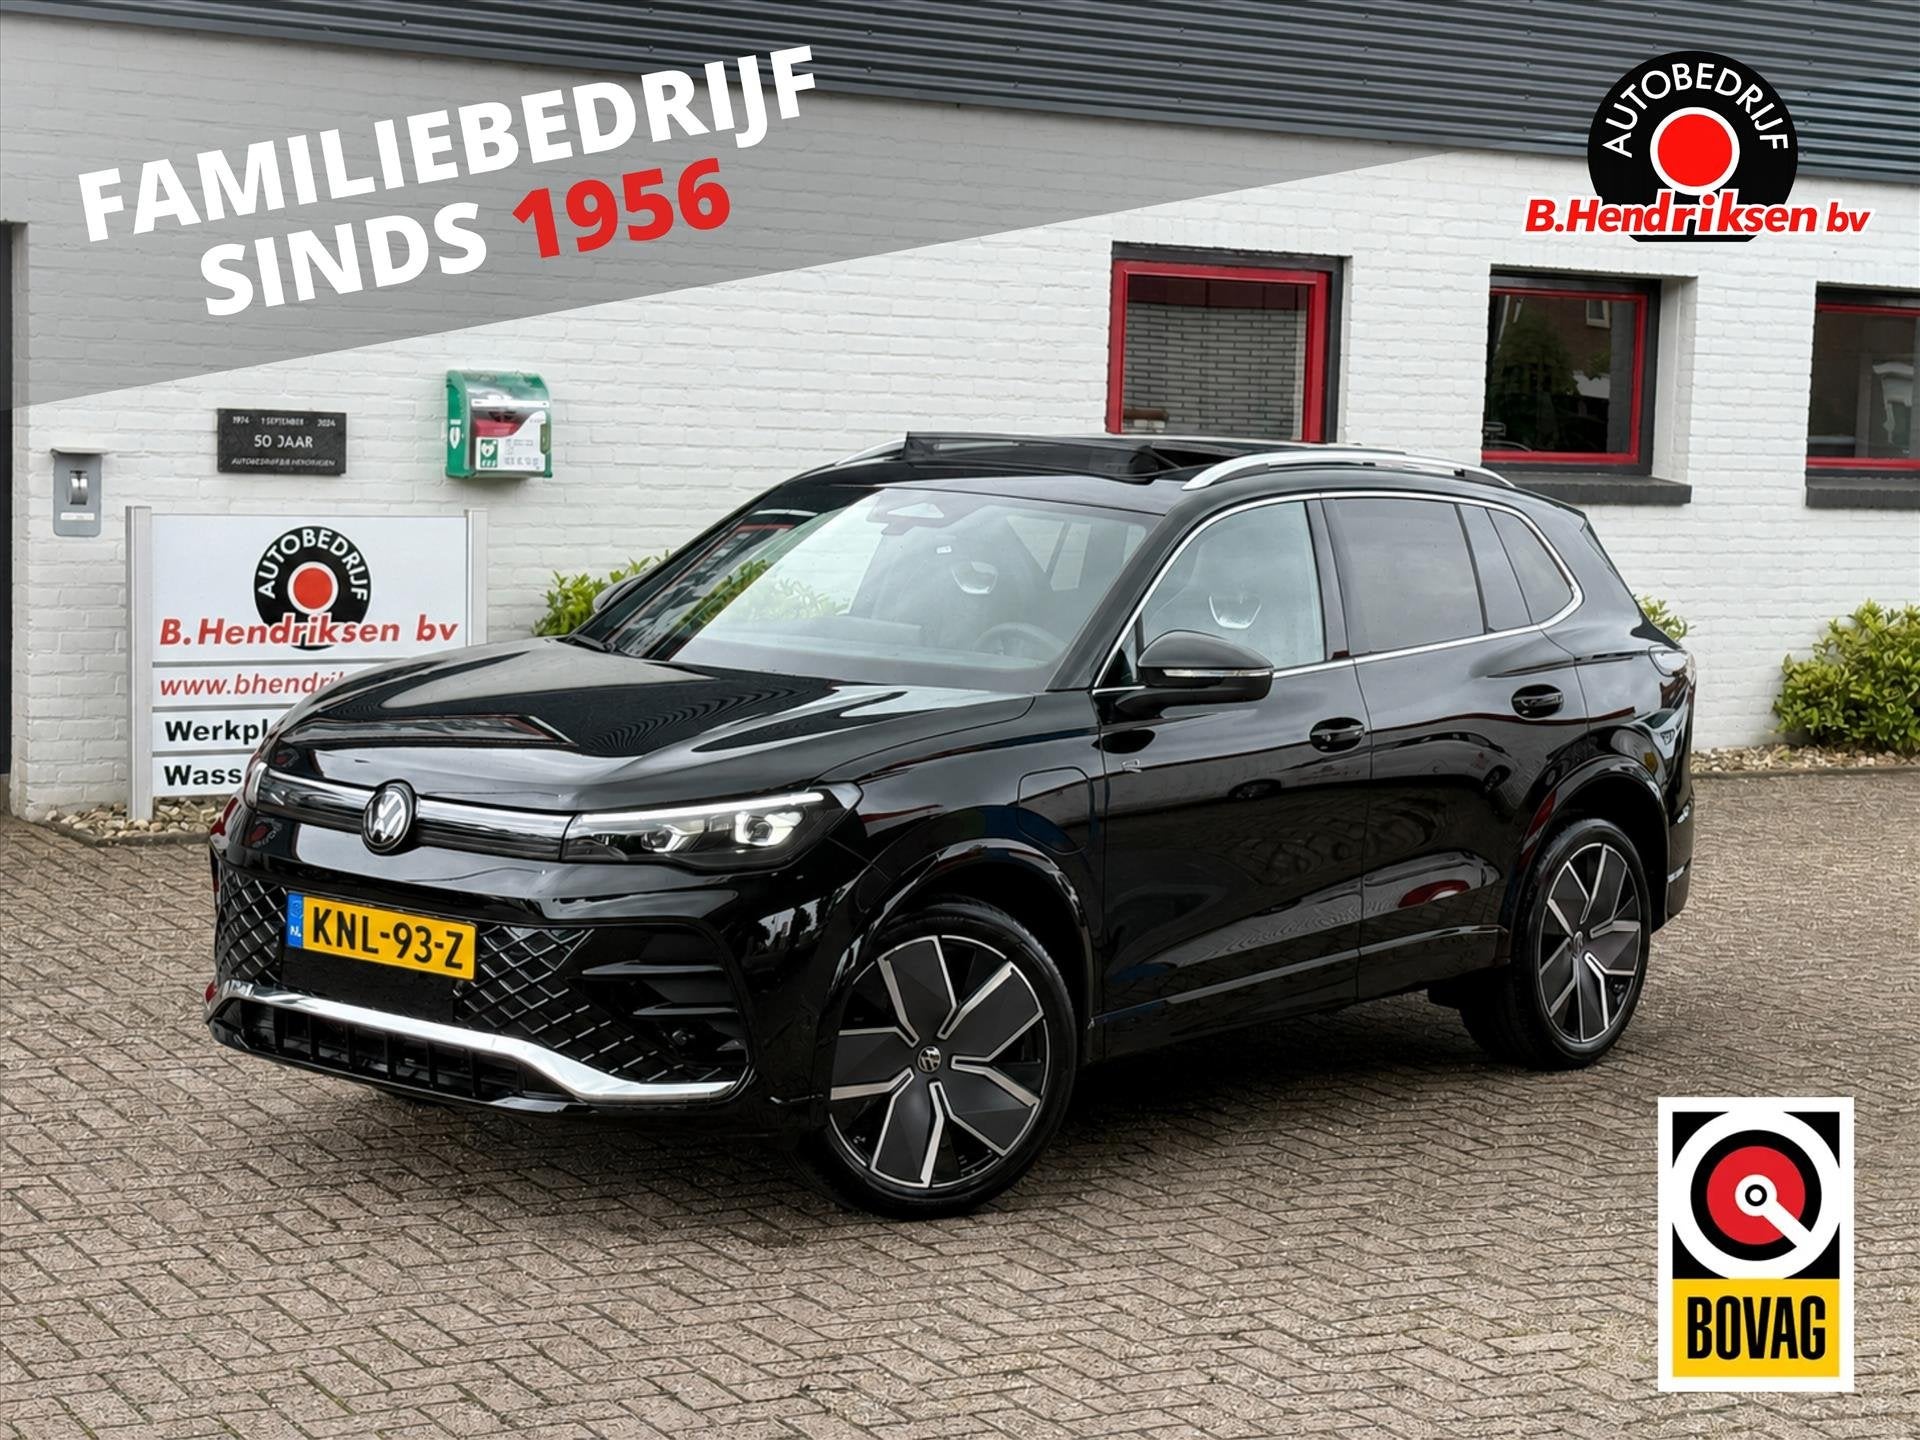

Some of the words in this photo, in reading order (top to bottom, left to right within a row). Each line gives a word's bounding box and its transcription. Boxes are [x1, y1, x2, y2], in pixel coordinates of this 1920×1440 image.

[254, 435, 272, 448] 50
[277, 435, 313, 448] JAAR
[257, 528, 368, 601] AUTOBEDRIJF
[416, 614, 459, 641] bv
[164, 718, 268, 746] Werkpl
[163, 764, 242, 786] Wass
[289, 924, 302, 938] NL
[312, 906, 464, 970] KNL-93-Z
